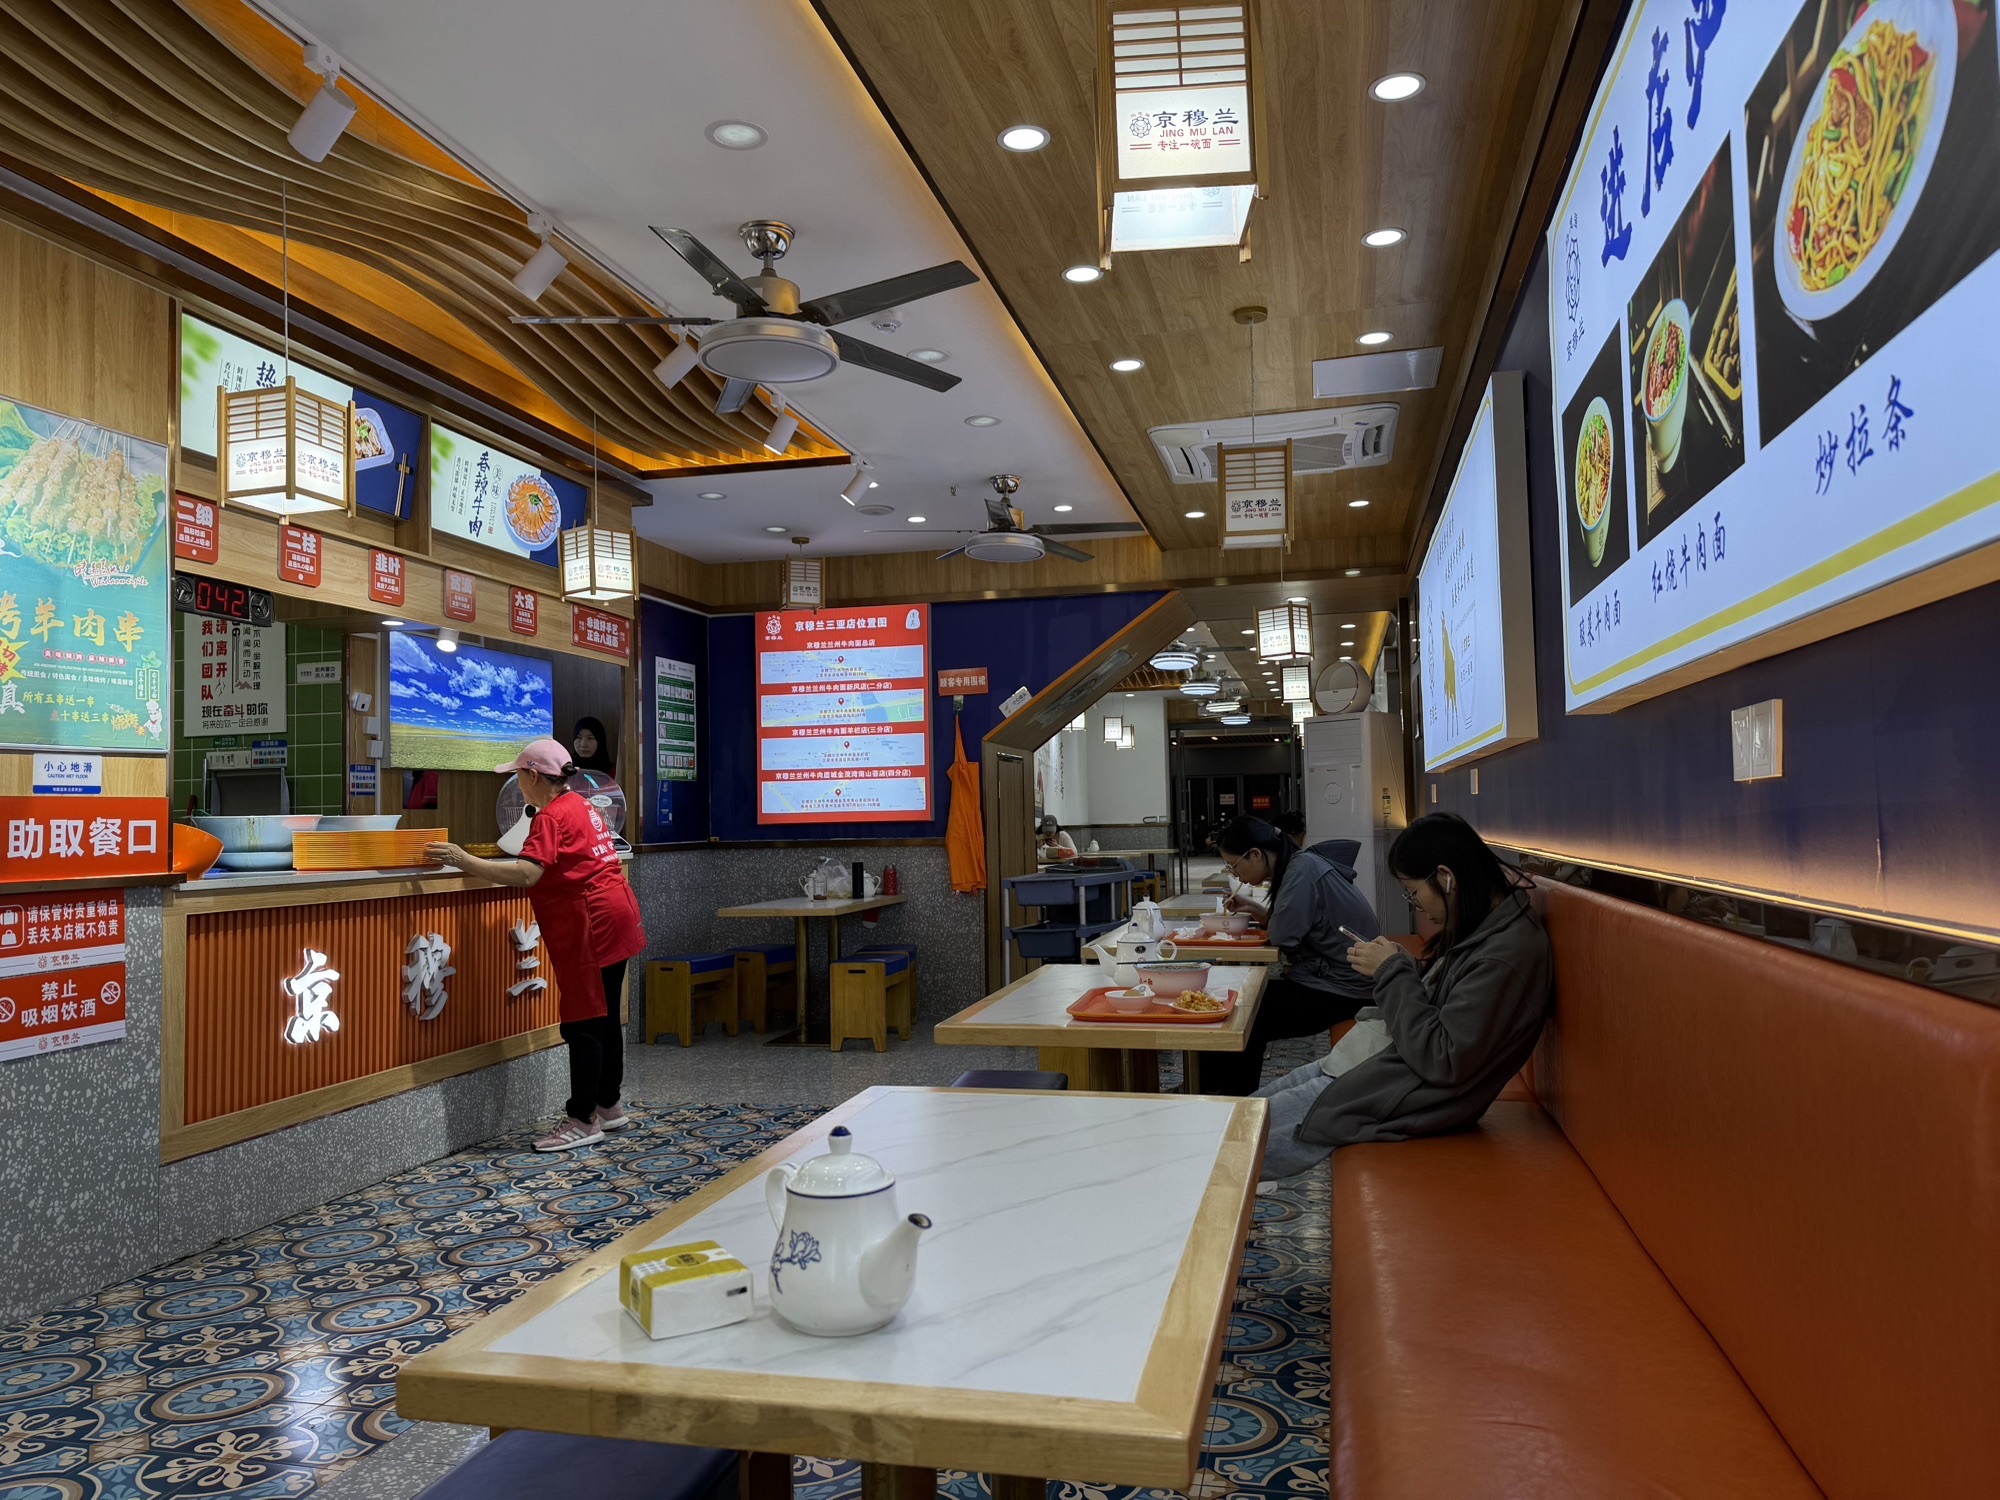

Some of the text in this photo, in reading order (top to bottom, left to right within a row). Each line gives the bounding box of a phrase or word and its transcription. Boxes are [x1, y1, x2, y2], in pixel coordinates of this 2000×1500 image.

[1153, 108, 1239, 128] 京穆兰
[1159, 126, 1234, 138] JING MU LAN
[1157, 138, 1211, 151] 专注一碗面
[1815, 374, 1914, 496] 炒拉条
[247, 448, 287, 462] 京穆兰
[307, 454, 340, 474] 京穆兰
[469, 451, 490, 538] 香辣牛肉
[1242, 499, 1281, 508] 京穆兰
[177, 500, 213, 528] 二细
[286, 529, 317, 554] 二柱
[375, 553, 401, 576] 韭叶
[1651, 511, 1726, 604] 红烧牛肉面
[196, 582, 245, 617] 042
[515, 591, 534, 610] 大宽
[795, 617, 887, 632] 京穆兰三亚店位置图
[1579, 589, 1621, 648] 酸菜牛肉面
[216, 619, 228, 678] 请离开
[806, 639, 876, 649] 京穆兰兰州牛肉面总店
[202, 620, 214, 701] 我们团队
[940, 675, 986, 688] 顾客专用围裙
[23, 691, 95, 707] 所有五串送一串
[202, 702, 269, 719] 现在奋斗的你
[44, 761, 92, 773] 小心地滑
[7, 817, 157, 860] 助取餐口
[27, 899, 118, 924] 请保管好贵重物品
[27, 919, 119, 945] 丢失本店概不负责
[51, 953, 80, 963] 京穆兰
[41, 979, 78, 1001] 禁止
[283, 918, 548, 1044] 京穆兰
[21, 998, 96, 1028] 吸烟饮酒
[51, 1033, 80, 1043] 京穆兰
